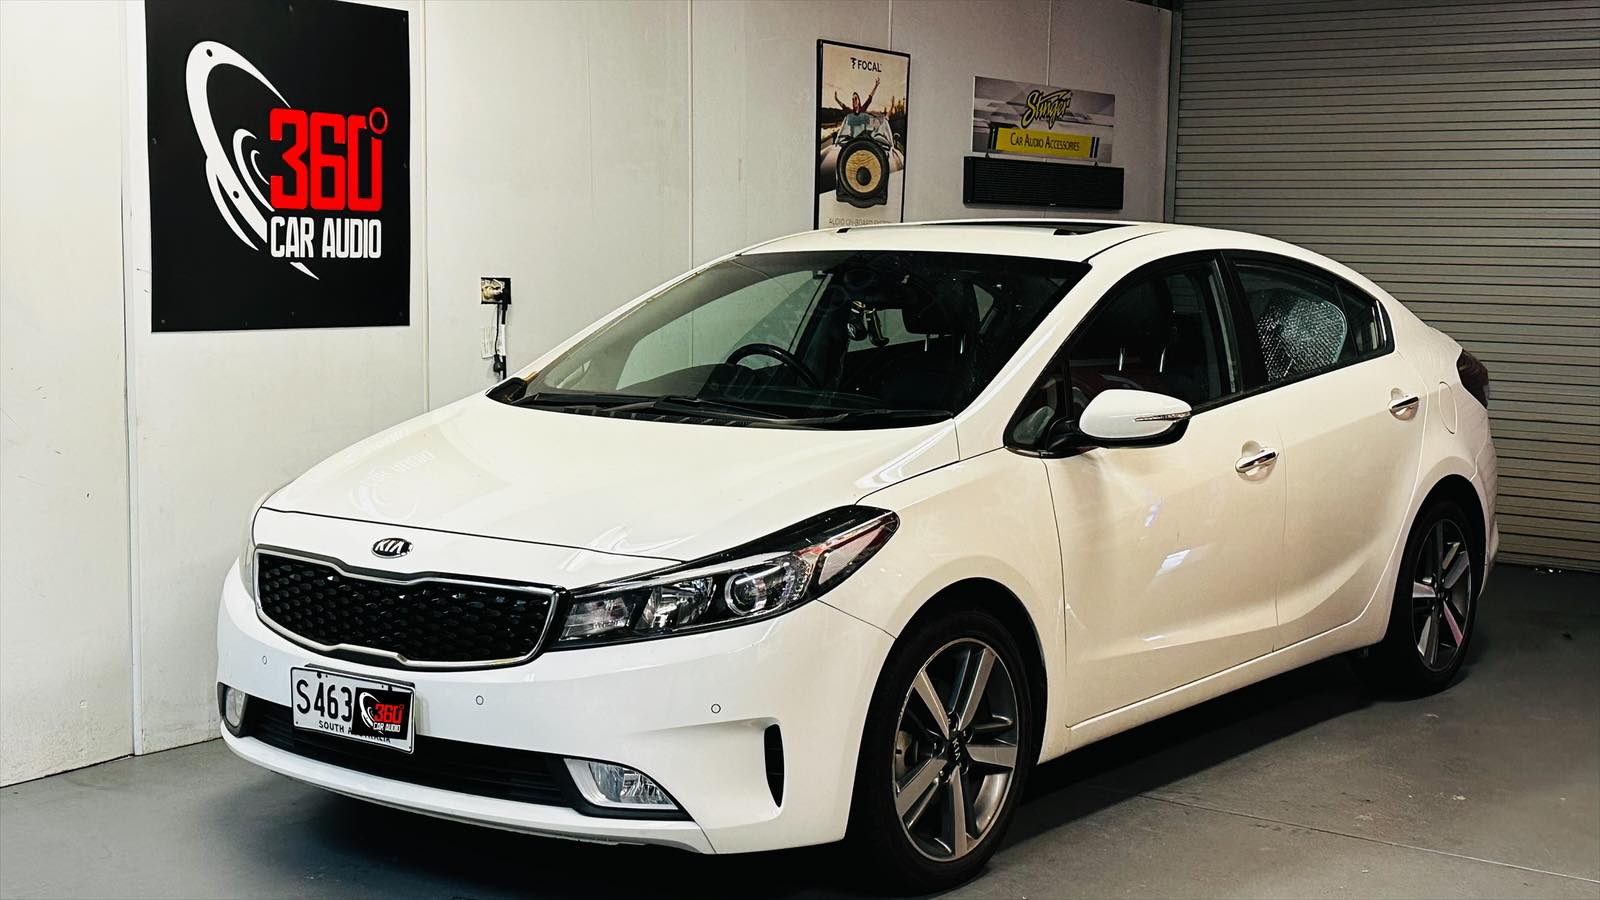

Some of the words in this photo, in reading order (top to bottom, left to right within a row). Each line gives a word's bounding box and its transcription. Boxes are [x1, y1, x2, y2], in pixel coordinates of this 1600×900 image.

[857, 59, 882, 73] FOCAL
[1021, 89, 1073, 130] Stinger
[270, 215, 315, 259] CAR
[321, 217, 382, 259] AUDIO
[374, 539, 405, 554] KIA
[318, 720, 345, 733] SOUTH
